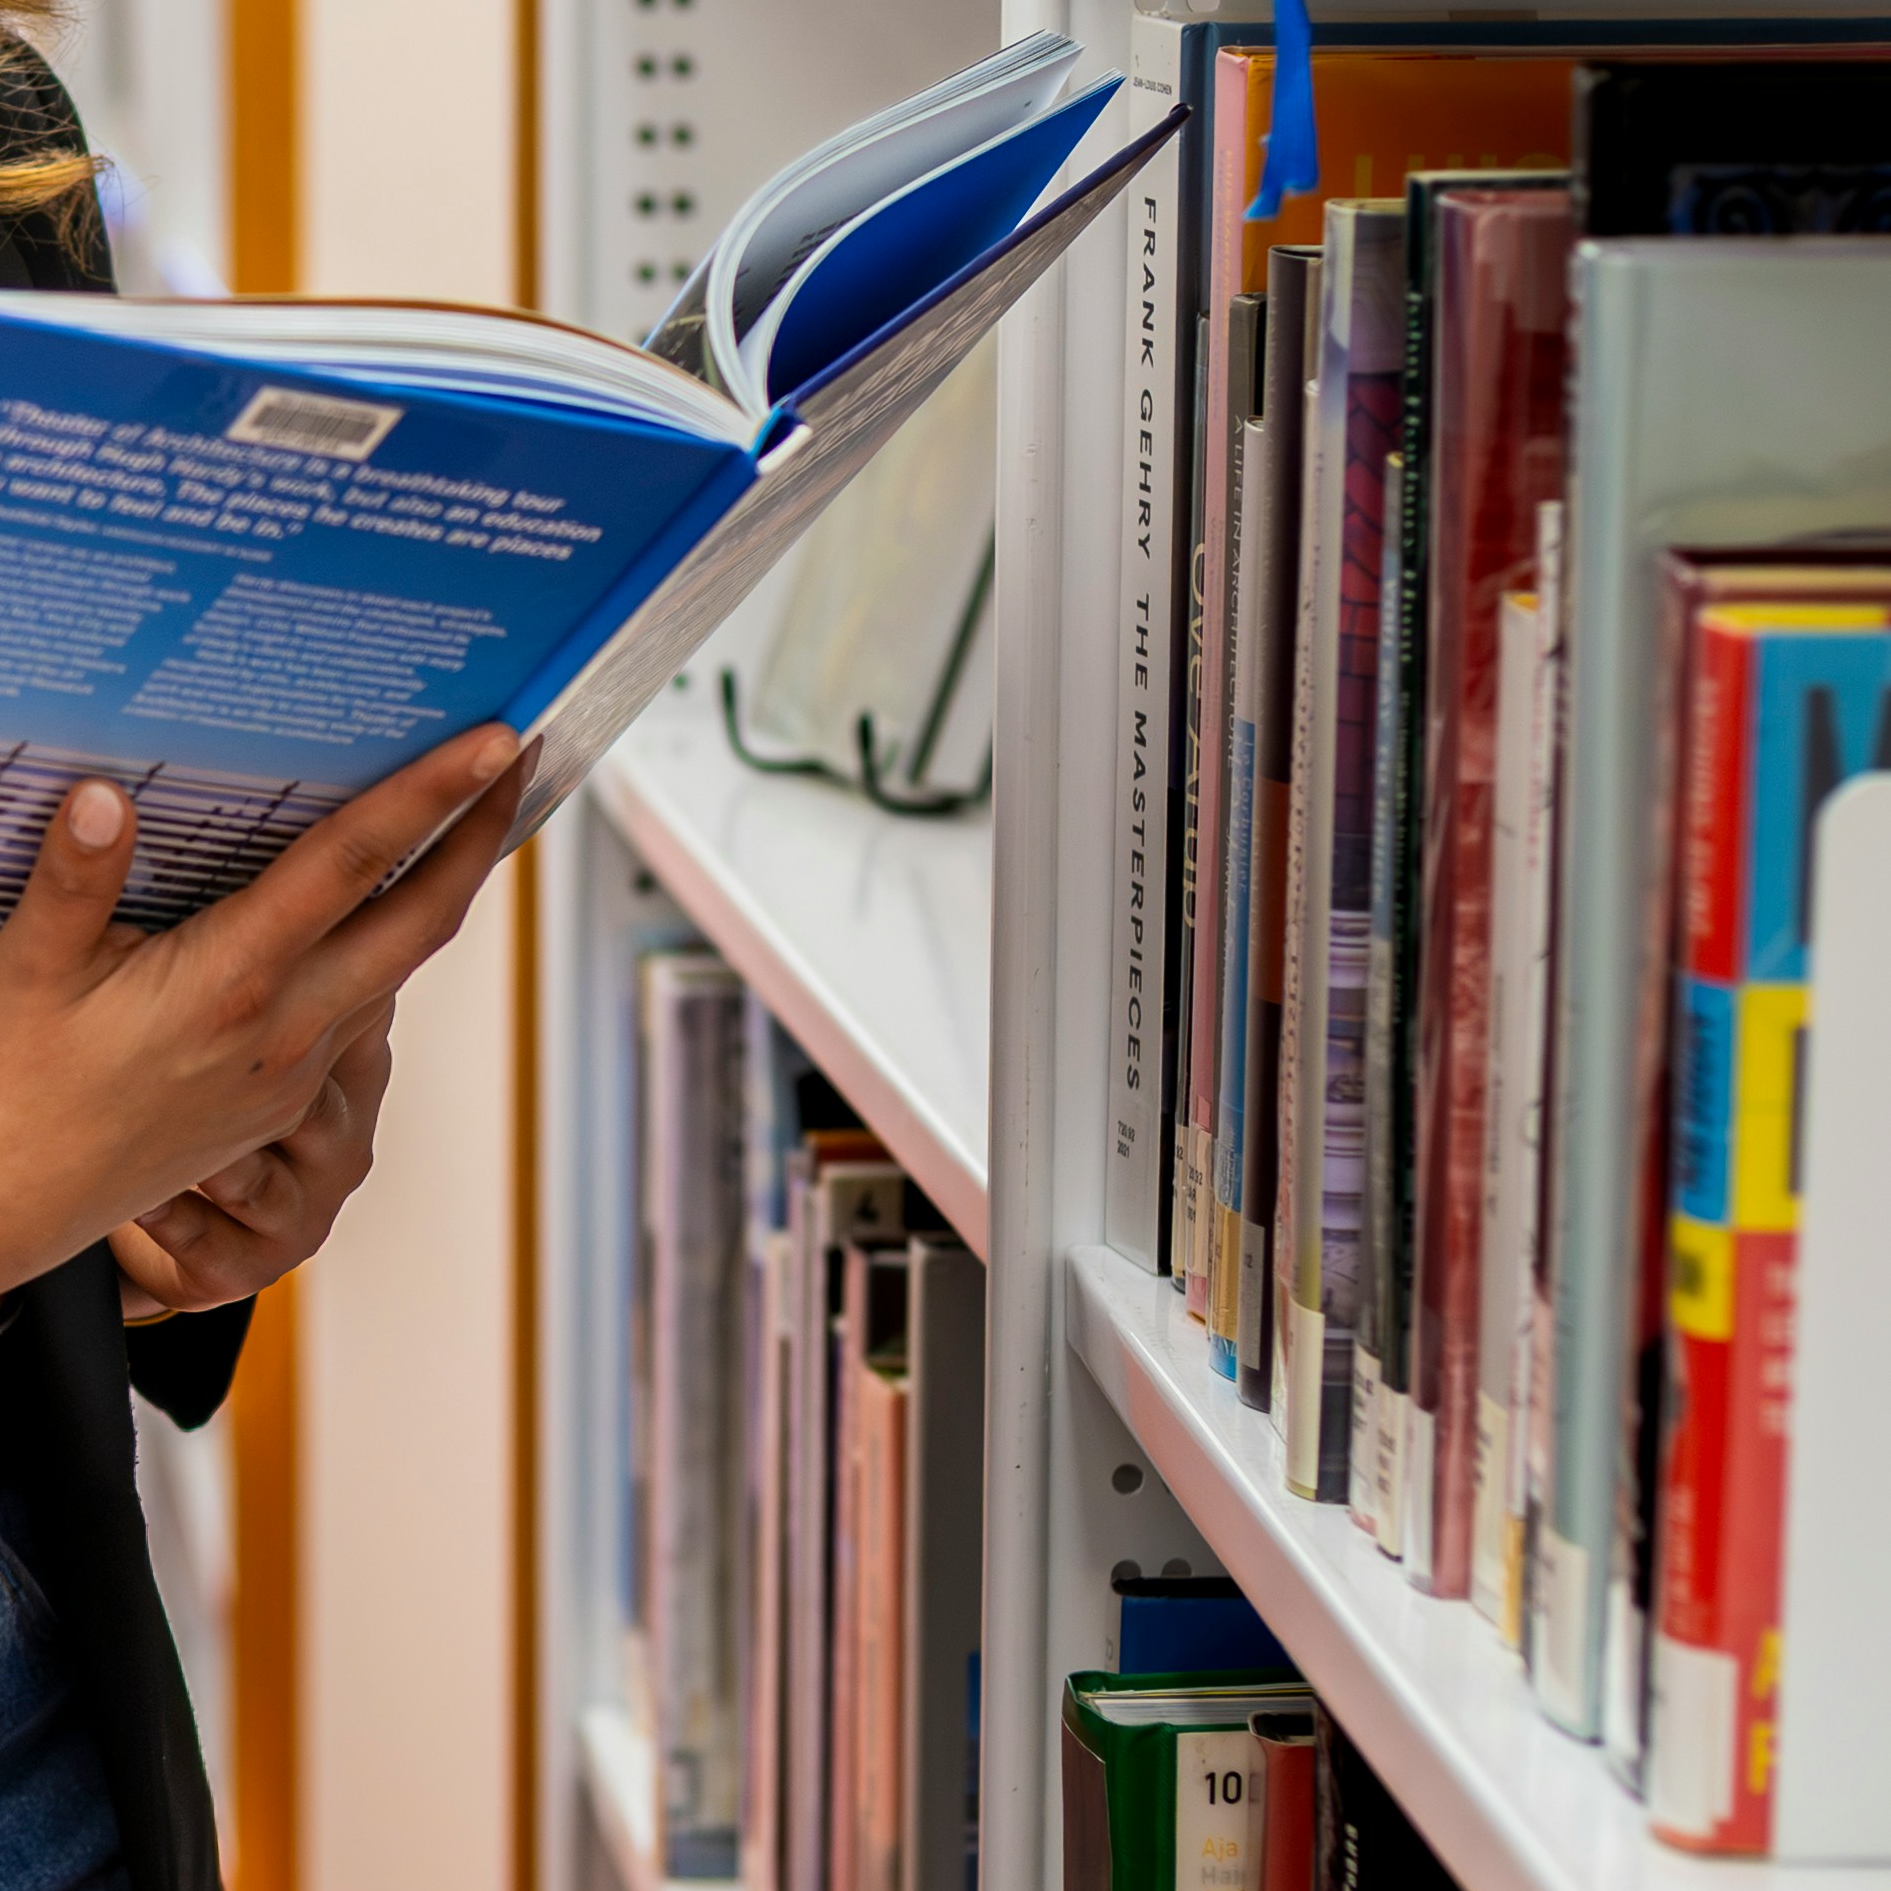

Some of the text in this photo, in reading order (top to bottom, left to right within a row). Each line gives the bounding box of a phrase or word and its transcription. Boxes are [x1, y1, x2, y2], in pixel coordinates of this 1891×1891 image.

[1233, 443, 1242, 501] LIFE
[1232, 509, 1241, 541] IN
[1125, 195, 1158, 1093] FRANK GEHRY THE MASTERPIECES
[1204, 1770, 1243, 1806] 10
